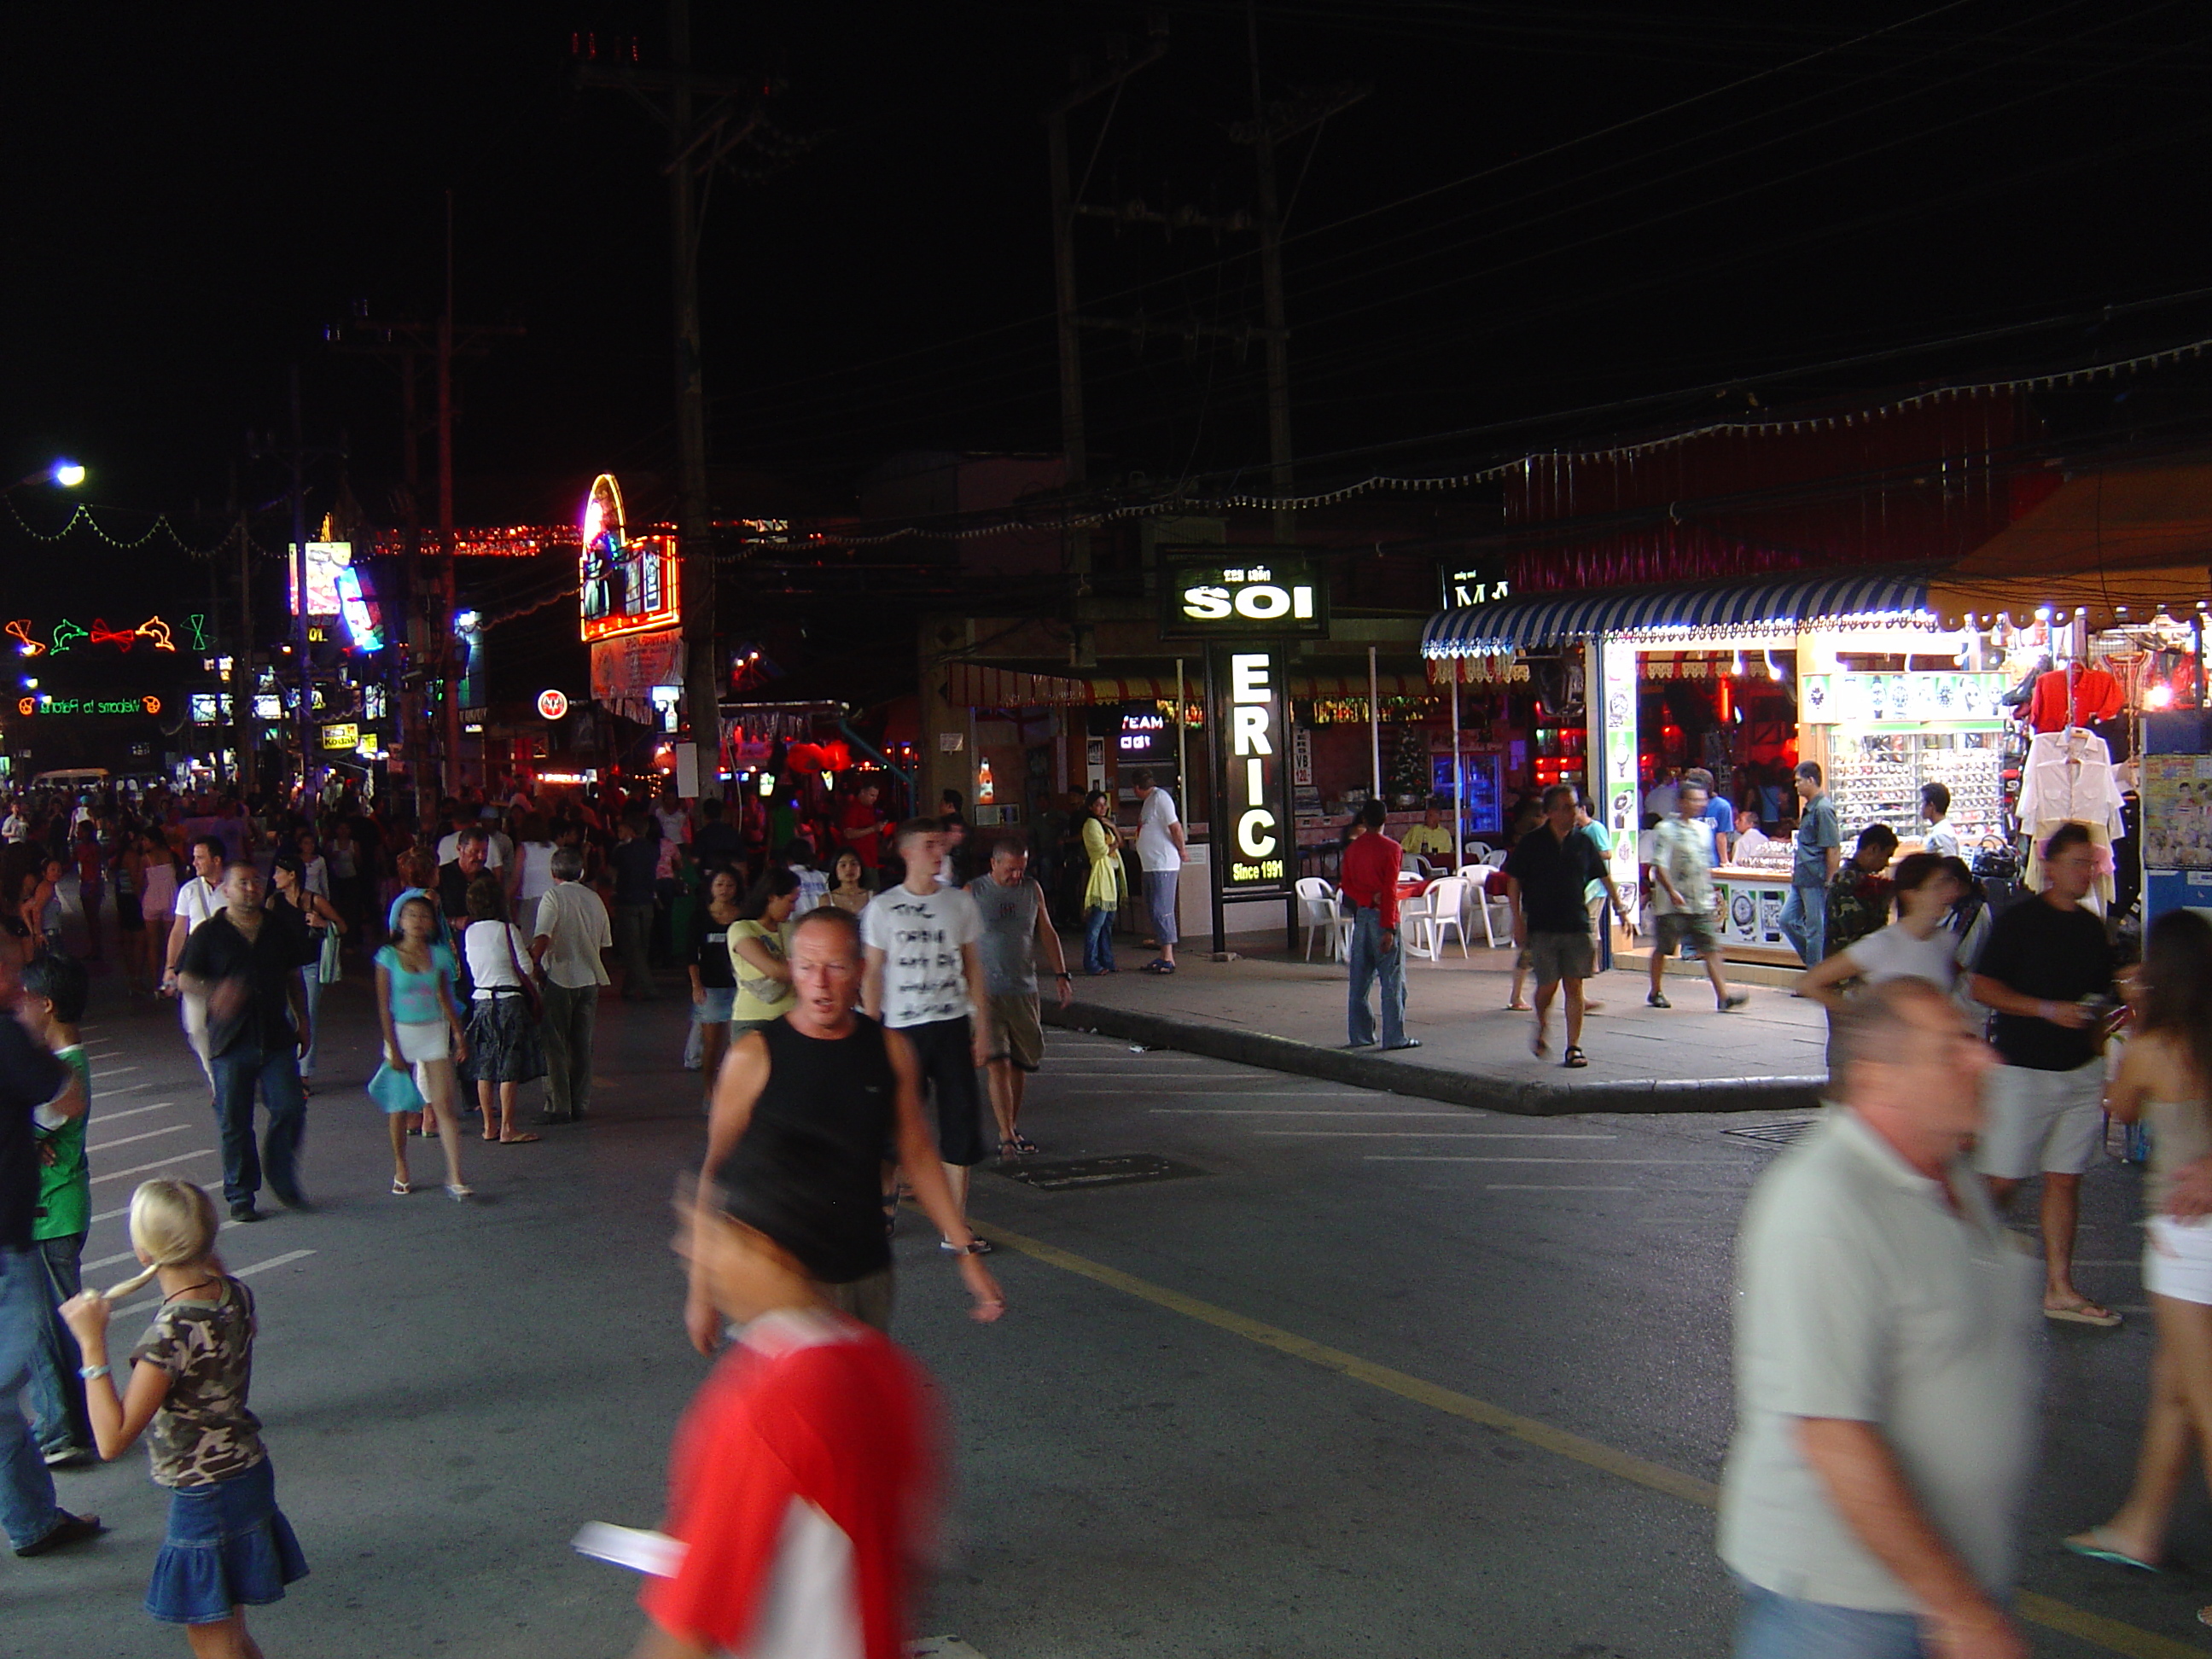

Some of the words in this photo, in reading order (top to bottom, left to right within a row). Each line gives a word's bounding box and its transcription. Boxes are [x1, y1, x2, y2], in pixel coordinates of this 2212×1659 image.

[1183, 585, 1313, 619] SOI
[324, 736, 357, 746] Kodak
[1231, 653, 1276, 859] ERIC
[1296, 755, 1308, 767] VB
[1232, 862, 1260, 882] Since
[1260, 859, 1284, 879] 1991
